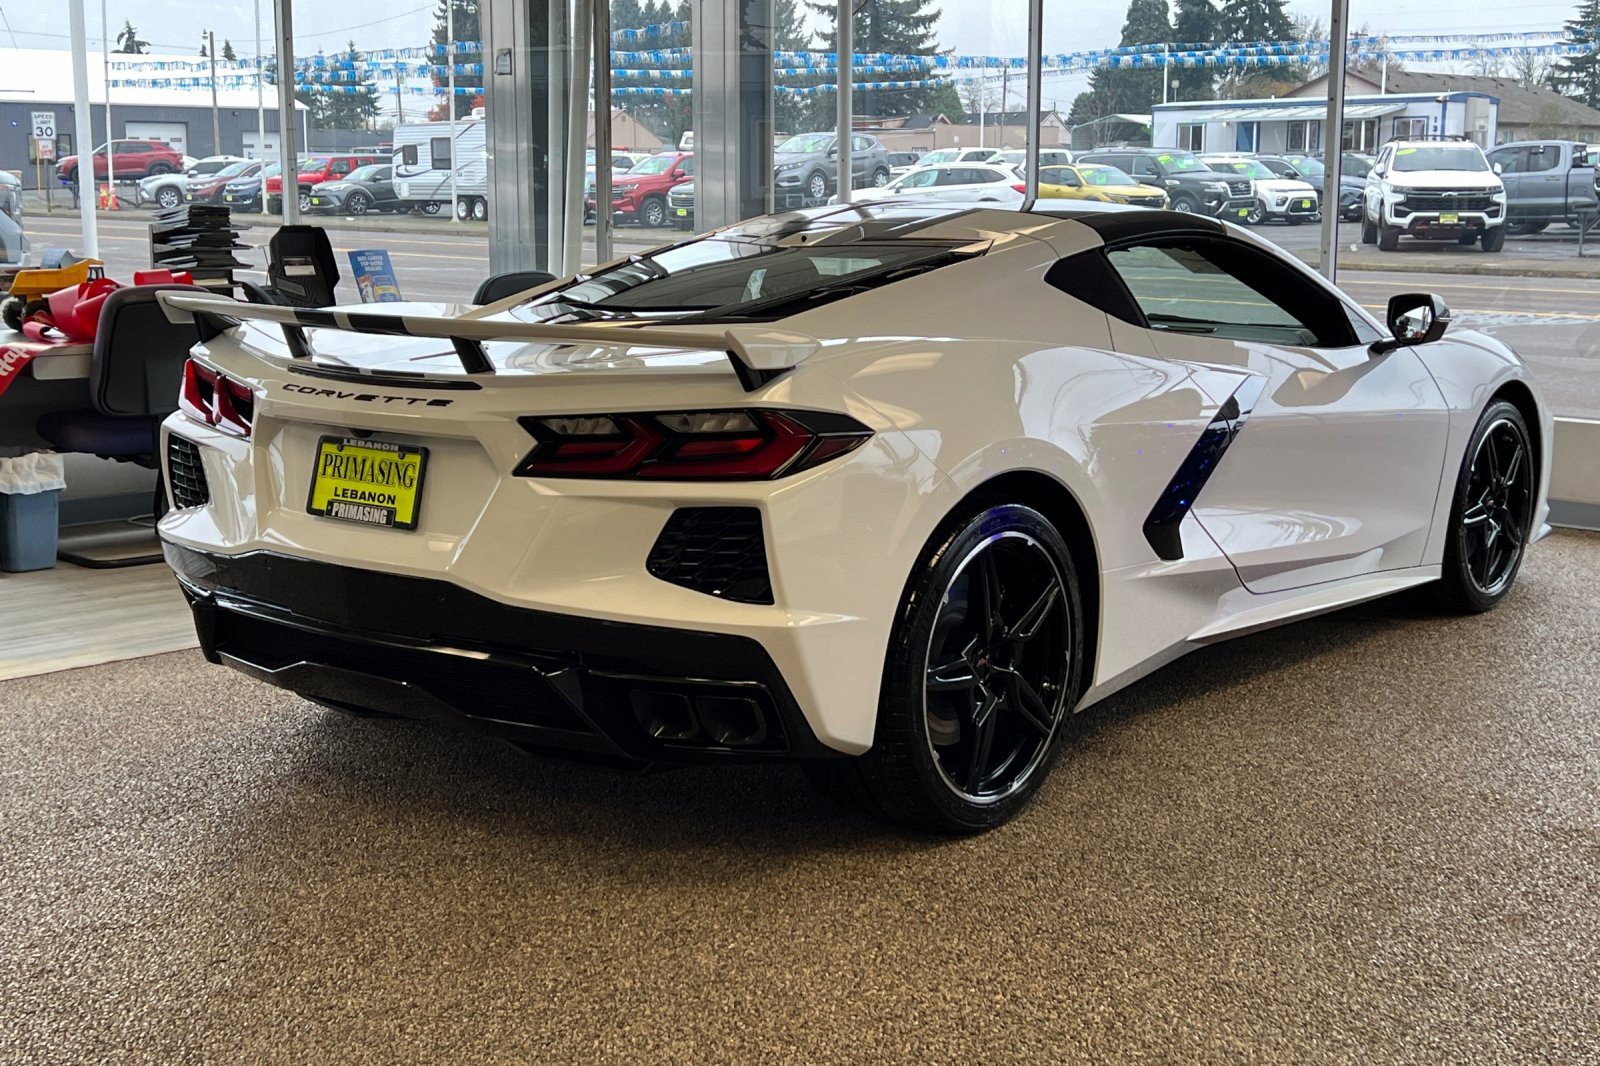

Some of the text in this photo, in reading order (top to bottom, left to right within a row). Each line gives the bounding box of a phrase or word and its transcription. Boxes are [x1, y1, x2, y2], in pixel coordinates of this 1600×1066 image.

[35, 126, 53, 137] 30
[282, 383, 454, 407] CORVETTE
[343, 438, 399, 451] LEBANON
[321, 453, 416, 488] PRIMASING
[334, 486, 396, 505] LEBANON
[331, 502, 388, 524] PRIMASING
